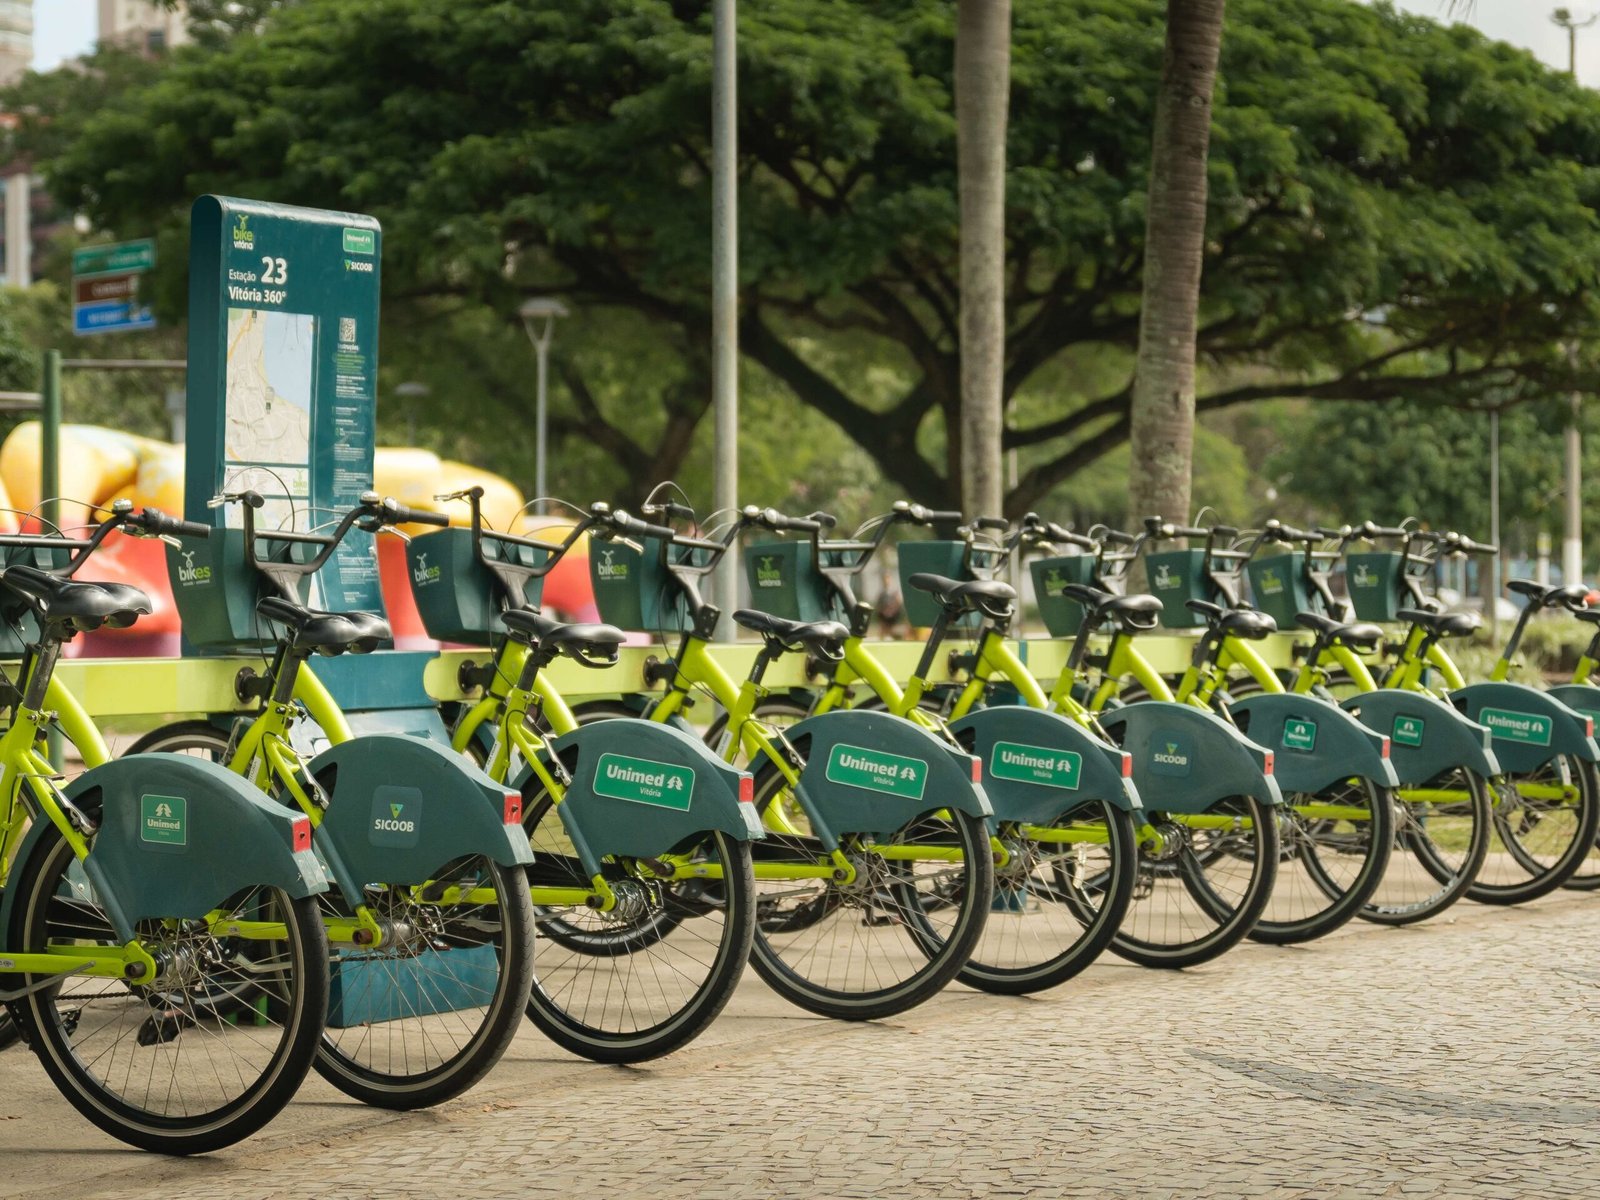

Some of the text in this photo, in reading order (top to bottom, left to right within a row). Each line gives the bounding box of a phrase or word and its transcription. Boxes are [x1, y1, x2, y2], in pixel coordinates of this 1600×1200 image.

[233, 225, 253, 241] bike
[228, 255, 288, 285] Estação 23
[350, 261, 373, 272] SICOOB
[228, 285, 262, 302] Vitória
[178, 565, 211, 582] bikes
[414, 566, 440, 582] bikes
[597, 561, 628, 576] bikes
[1486, 715, 1530, 730] Unimed
[839, 753, 898, 777] Unimed
[1002, 750, 1055, 770] Unimed
[1153, 753, 1187, 766] SICOOB
[606, 764, 665, 787] Unimed
[639, 786, 662, 798] Vitória
[147, 818, 181, 830] Unimed
[374, 818, 415, 833] SICOOB
